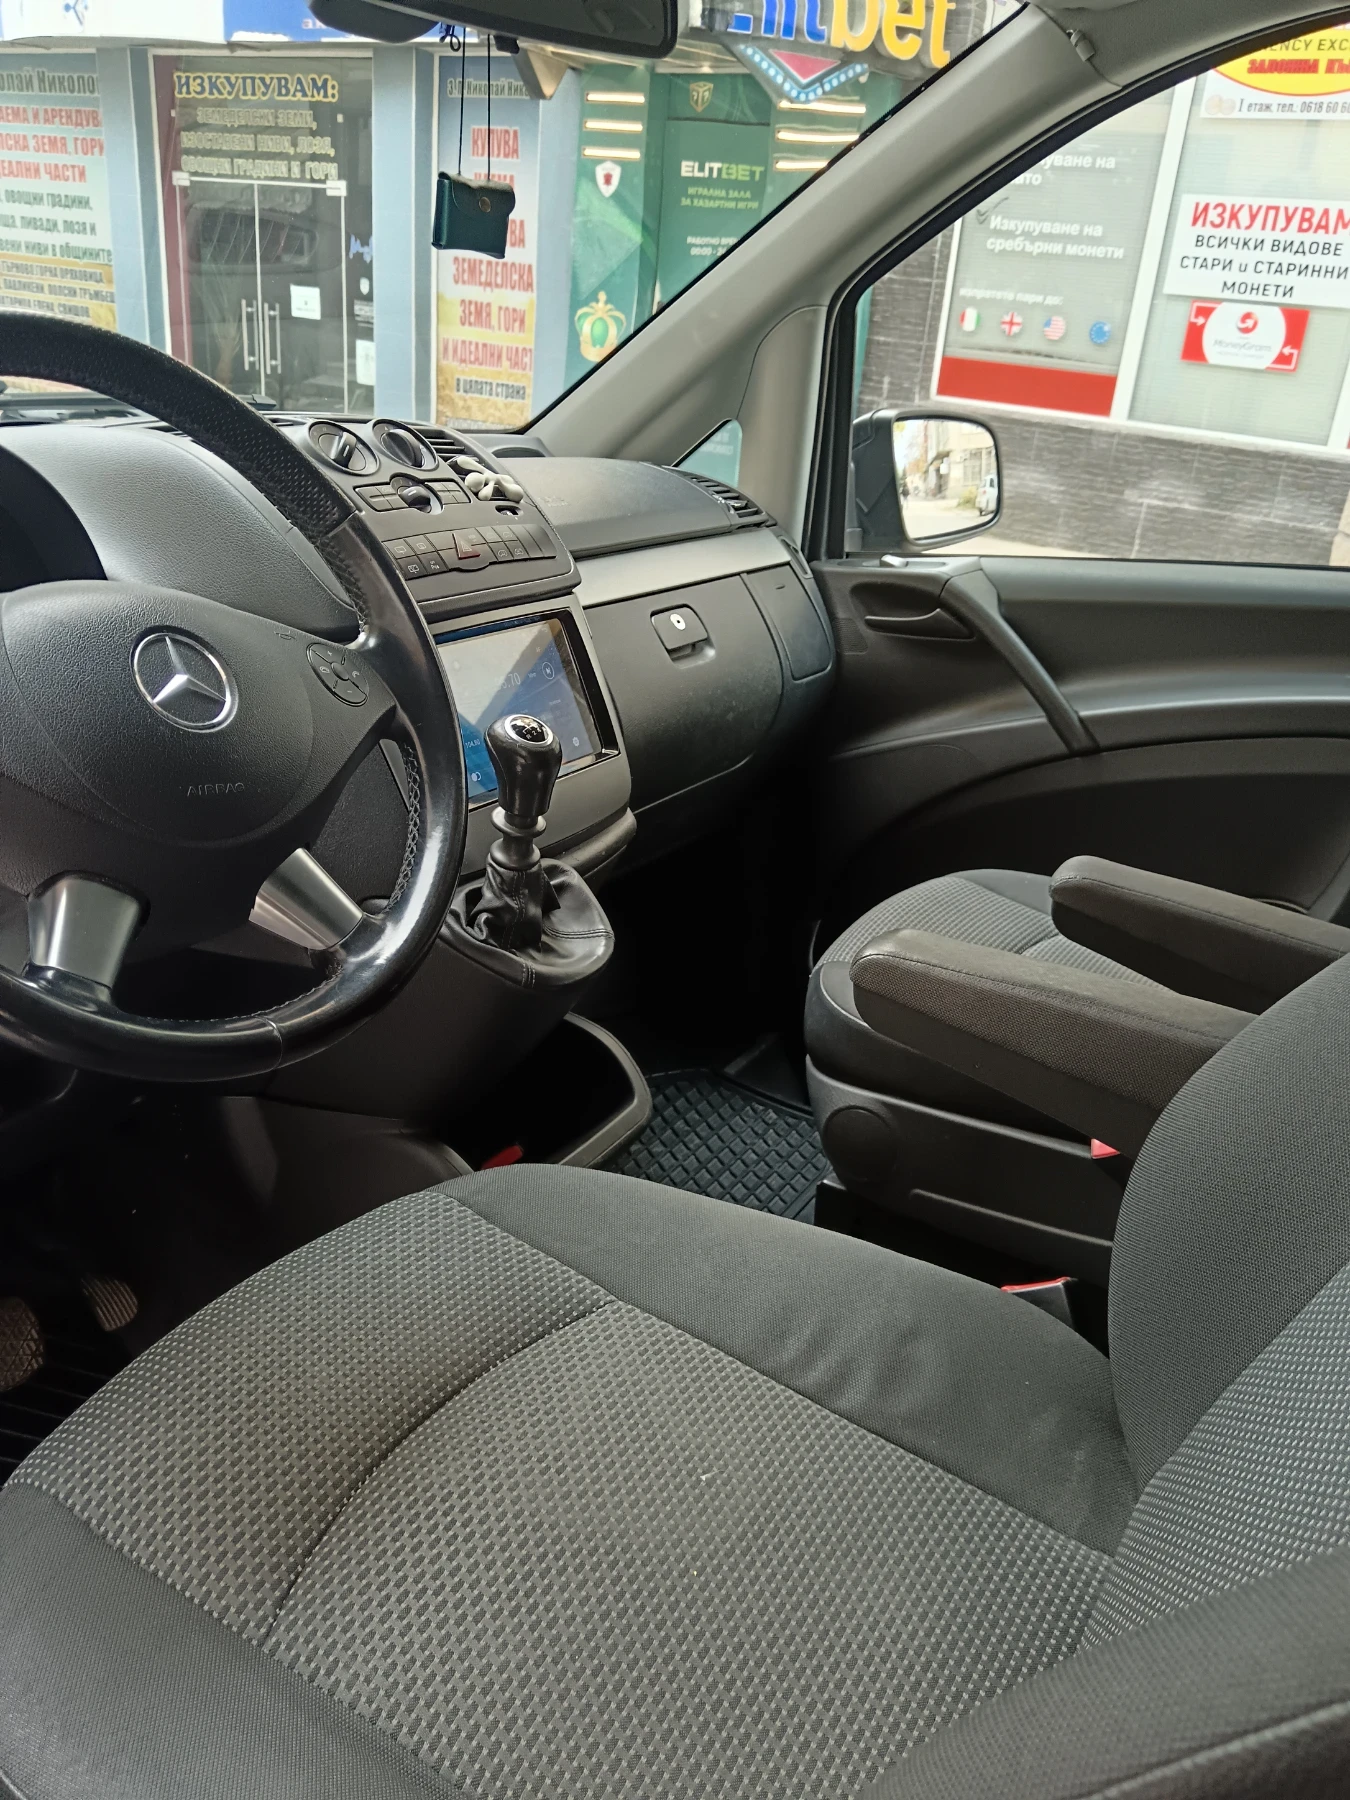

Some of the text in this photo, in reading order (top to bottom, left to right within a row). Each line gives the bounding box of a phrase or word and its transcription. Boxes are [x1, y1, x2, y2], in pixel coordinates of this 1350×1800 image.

[36, 69, 100, 95] Николо
[174, 72, 339, 102] ИЗКУПУВАМ:
[471, 127, 520, 159] КУПУВА
[43, 162, 87, 183] ЧАСТИ
[680, 160, 765, 181] ELITBET
[1037, 154, 1117, 170] уване на
[989, 214, 1104, 237] Изкупуване на
[1191, 201, 1350, 235] ИЗКУПУВАМ
[986, 236, 1125, 260] сребърни монети
[1195, 234, 1344, 257] ВСИЧКИ ВИДОВЕ
[453, 256, 534, 293] ЗЕМЕДЕЛСКА
[1180, 255, 1233, 272] СТАРИ
[1253, 261, 1349, 280] СТАРИННИ
[1221, 280, 1295, 299] МОНЕТИ
[497, 306, 526, 333] ГОРИ
[442, 337, 449, 361] И
[452, 339, 503, 370] ИДЕАЛНИ
[187, 782, 246, 797] AIRBAG
